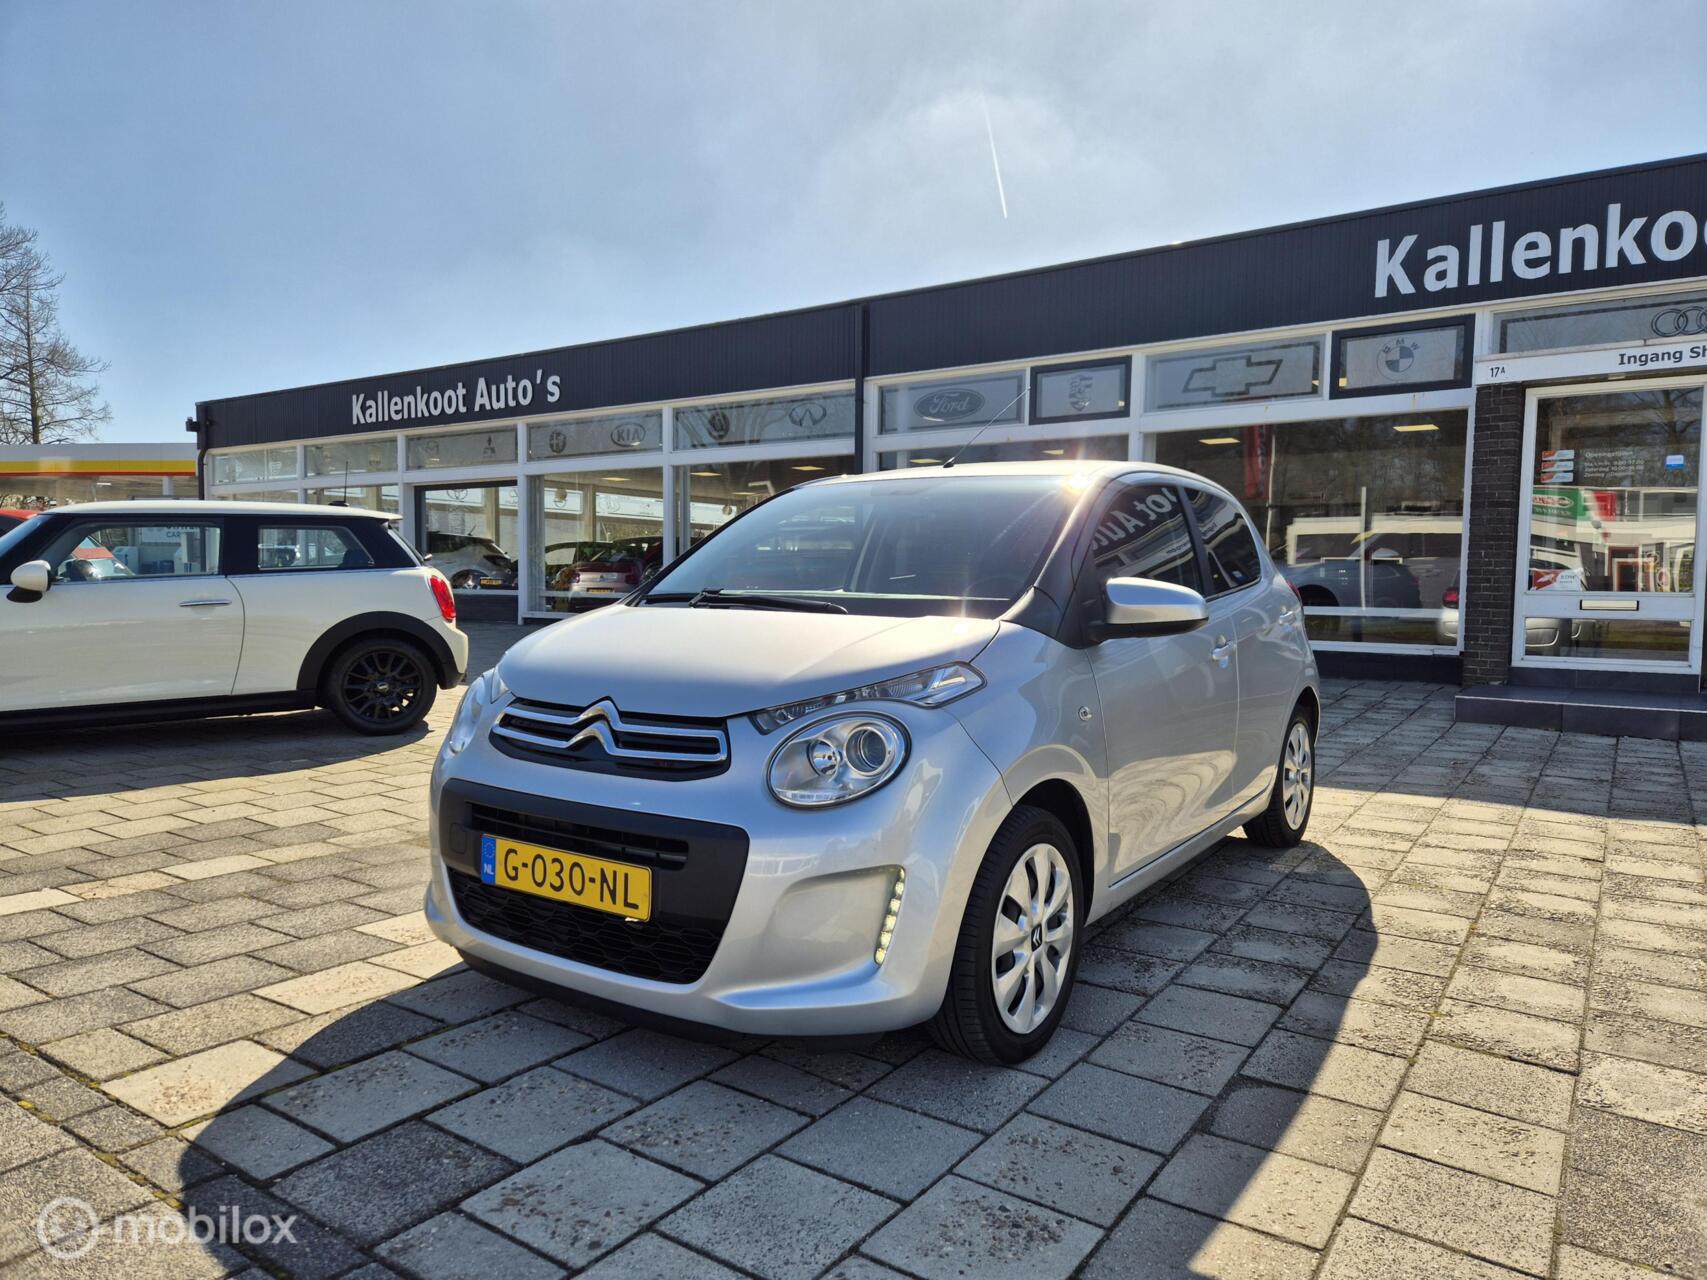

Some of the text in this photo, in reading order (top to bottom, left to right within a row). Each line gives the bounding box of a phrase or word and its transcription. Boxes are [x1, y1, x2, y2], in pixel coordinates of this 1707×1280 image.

[1374, 203, 1707, 298] Kallenko
[1618, 350, 1684, 366] Ingang
[352, 369, 561, 425] Kallenkoot Auto's
[617, 428, 640, 442] KIA
[483, 863, 494, 875] NL
[504, 848, 639, 910] G-030-NL
